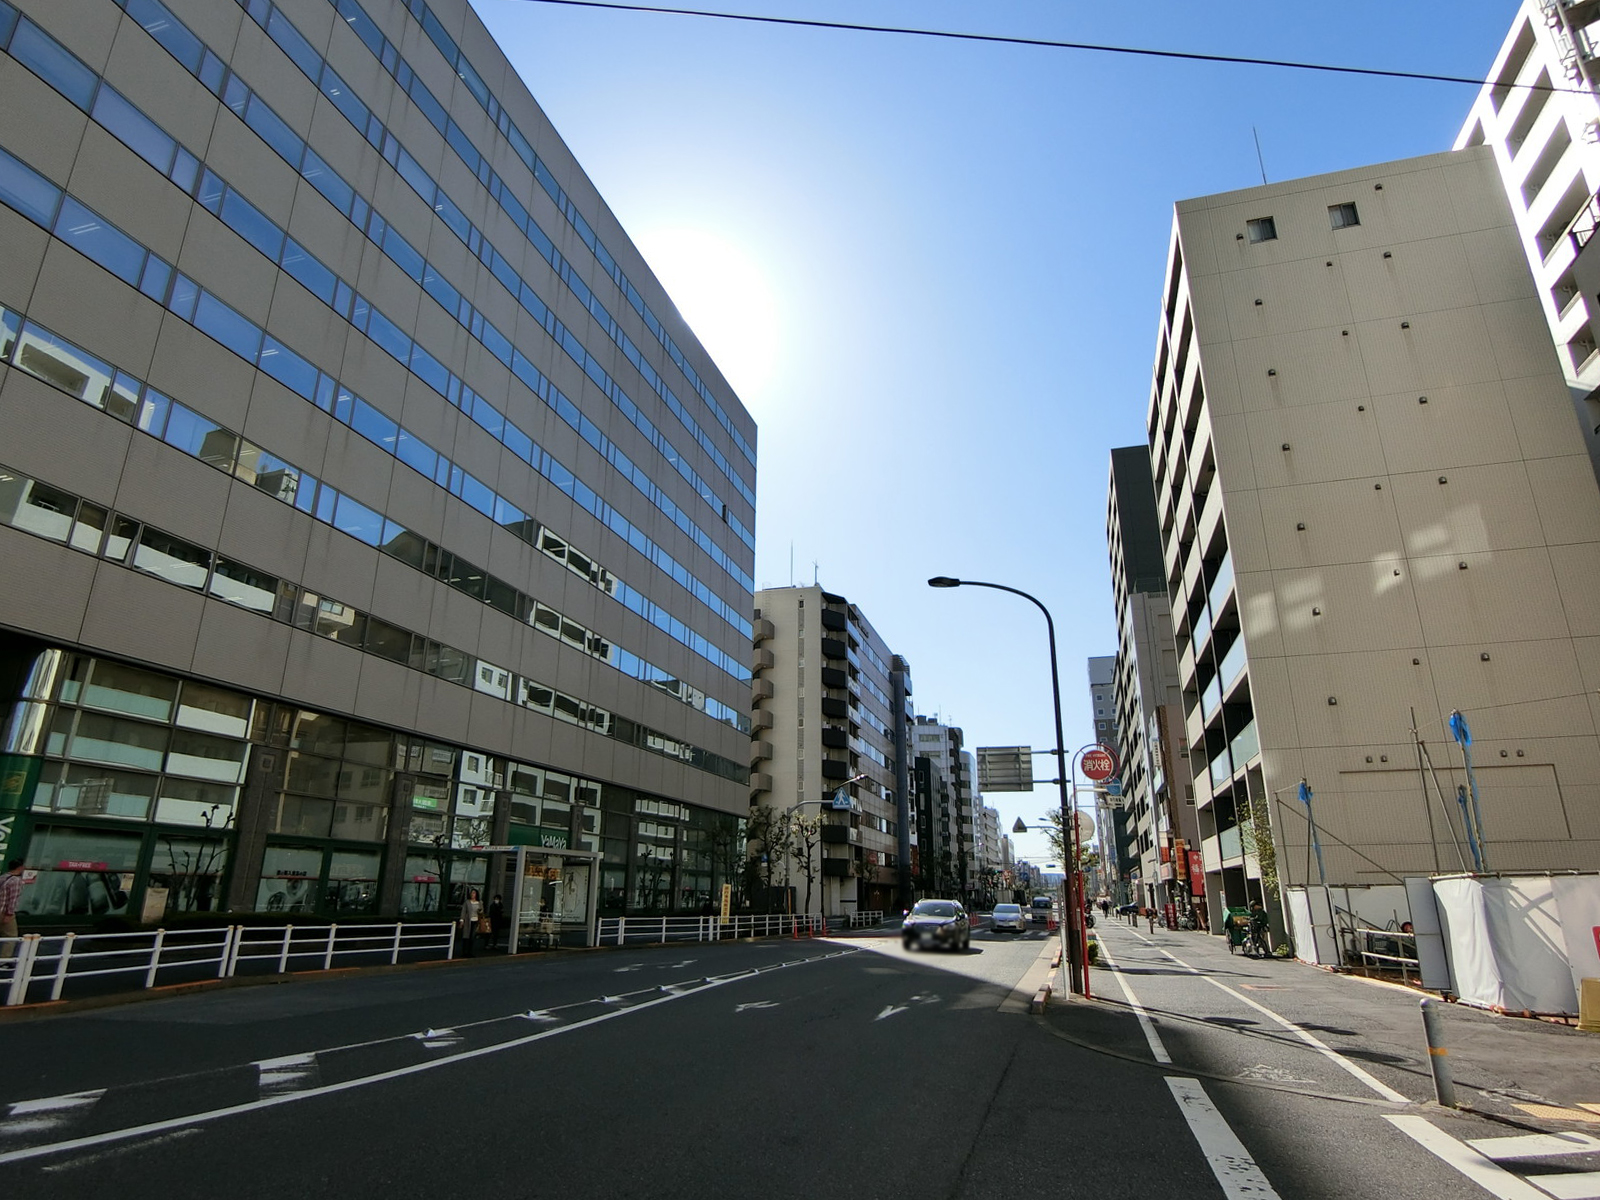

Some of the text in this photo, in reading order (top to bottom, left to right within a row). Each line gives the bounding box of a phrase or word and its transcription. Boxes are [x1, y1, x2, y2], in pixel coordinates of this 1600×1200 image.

[1083, 759, 1110, 771] 消火栓
[541, 834, 566, 850] YaMaYa
